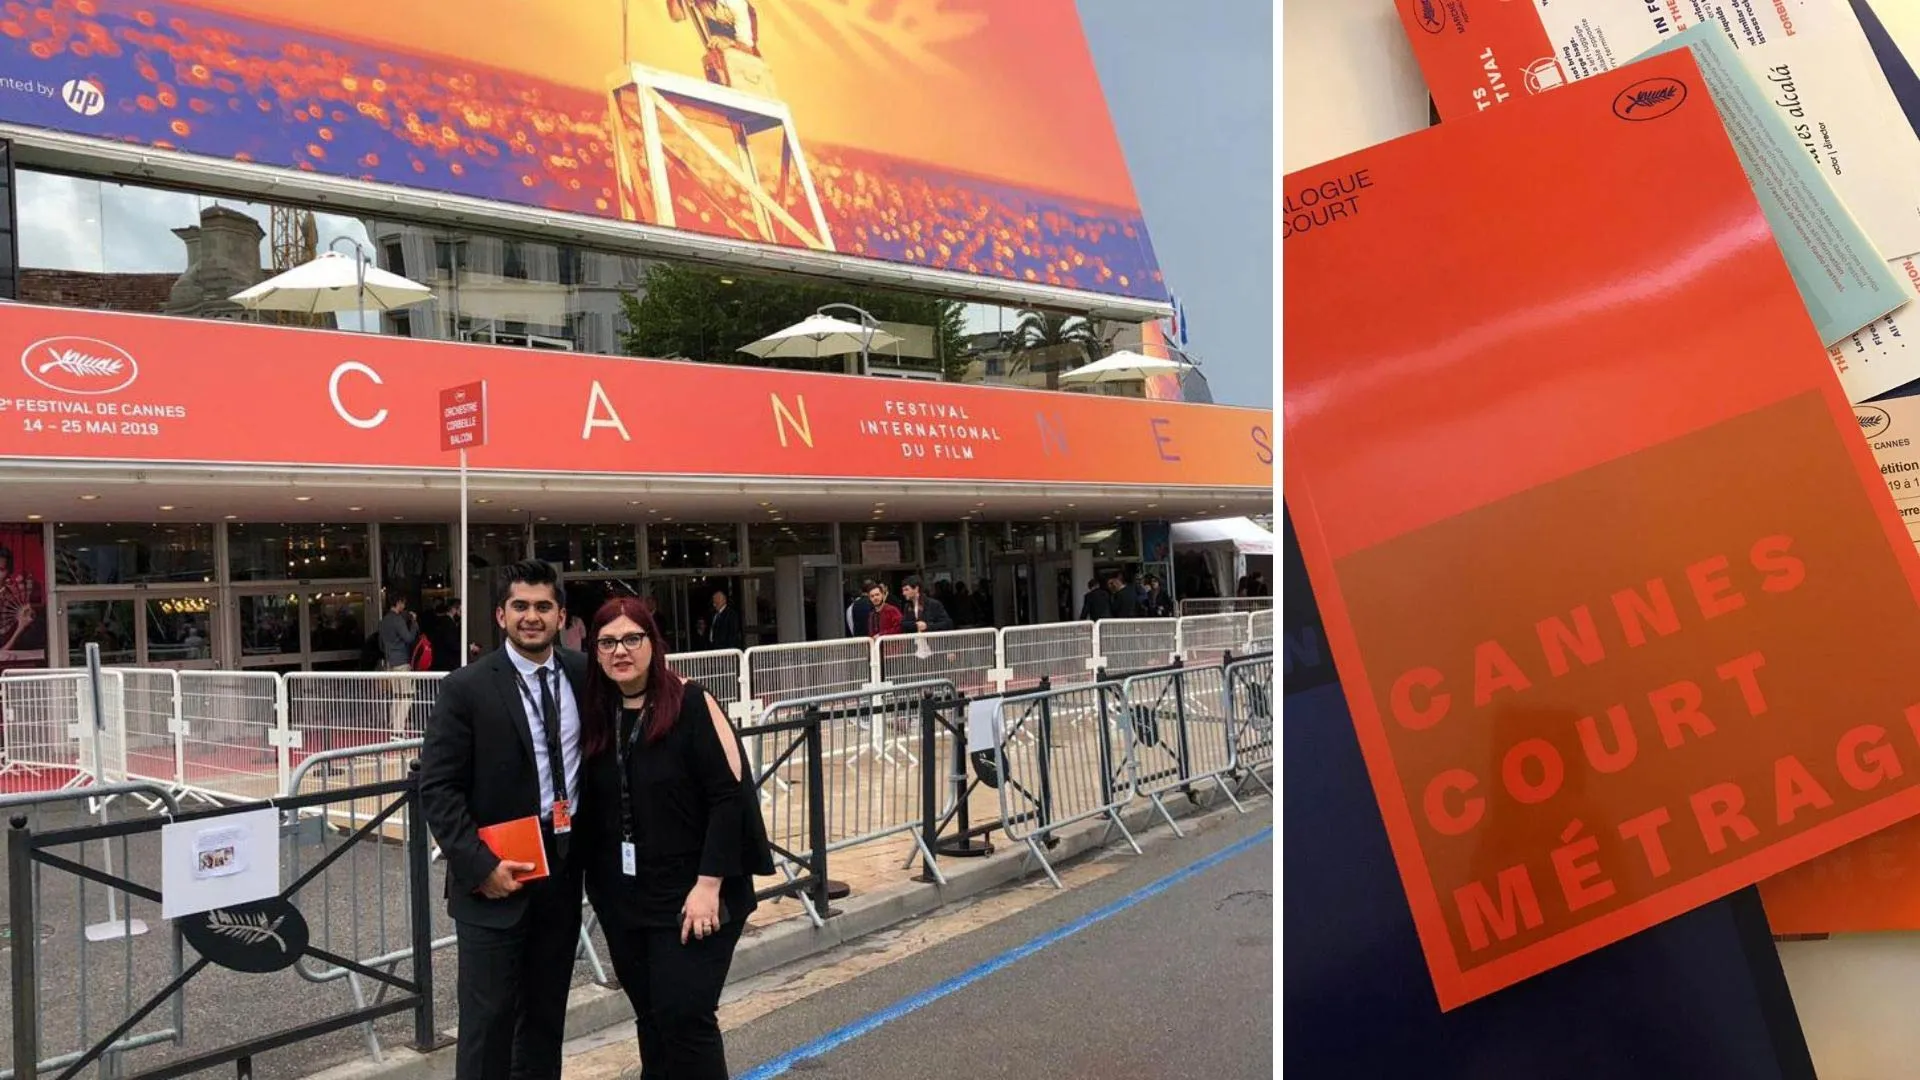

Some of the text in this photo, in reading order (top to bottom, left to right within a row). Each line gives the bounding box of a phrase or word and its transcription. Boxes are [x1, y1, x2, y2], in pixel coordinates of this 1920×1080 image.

[1581, 18, 1598, 49] opposite
[1654, 17, 1668, 34] IN
[1574, 25, 1589, 53] luggage
[1595, 25, 1612, 57] terminal.
[1563, 46, 1581, 79] not bring
[1570, 36, 1590, 77] large bags.
[1587, 53, 1596, 67] left
[1480, 47, 1510, 103] TIVAL
[37, 80, 55, 98] by
[67, 80, 100, 115] hp
[1473, 87, 1491, 112] TS
[1818, 121, 1833, 150] director
[1830, 156, 1841, 176] actor
[1830, 346, 1849, 374] THE
[16, 399, 93, 414] FESTIVAL
[97, 403, 118, 415] DE
[121, 404, 186, 418] CANNES
[885, 400, 969, 419] FESTIVAL
[24, 419, 43, 432] 14
[61, 420, 81, 433] 25
[86, 421, 116, 434] MAI
[121, 422, 160, 436] 2019
[450, 432, 473, 445] BALCON
[859, 420, 1001, 440] INTERNATIONAL
[902, 443, 974, 459] DU FILM
[1874, 439, 1910, 450] CANNES
[1881, 462, 1920, 474] étition
[1888, 480, 1901, 491] 19
[1389, 534, 1807, 732] CANNES
[1423, 650, 1769, 836] COURT
[1452, 702, 1920, 952] MÉTRAG
